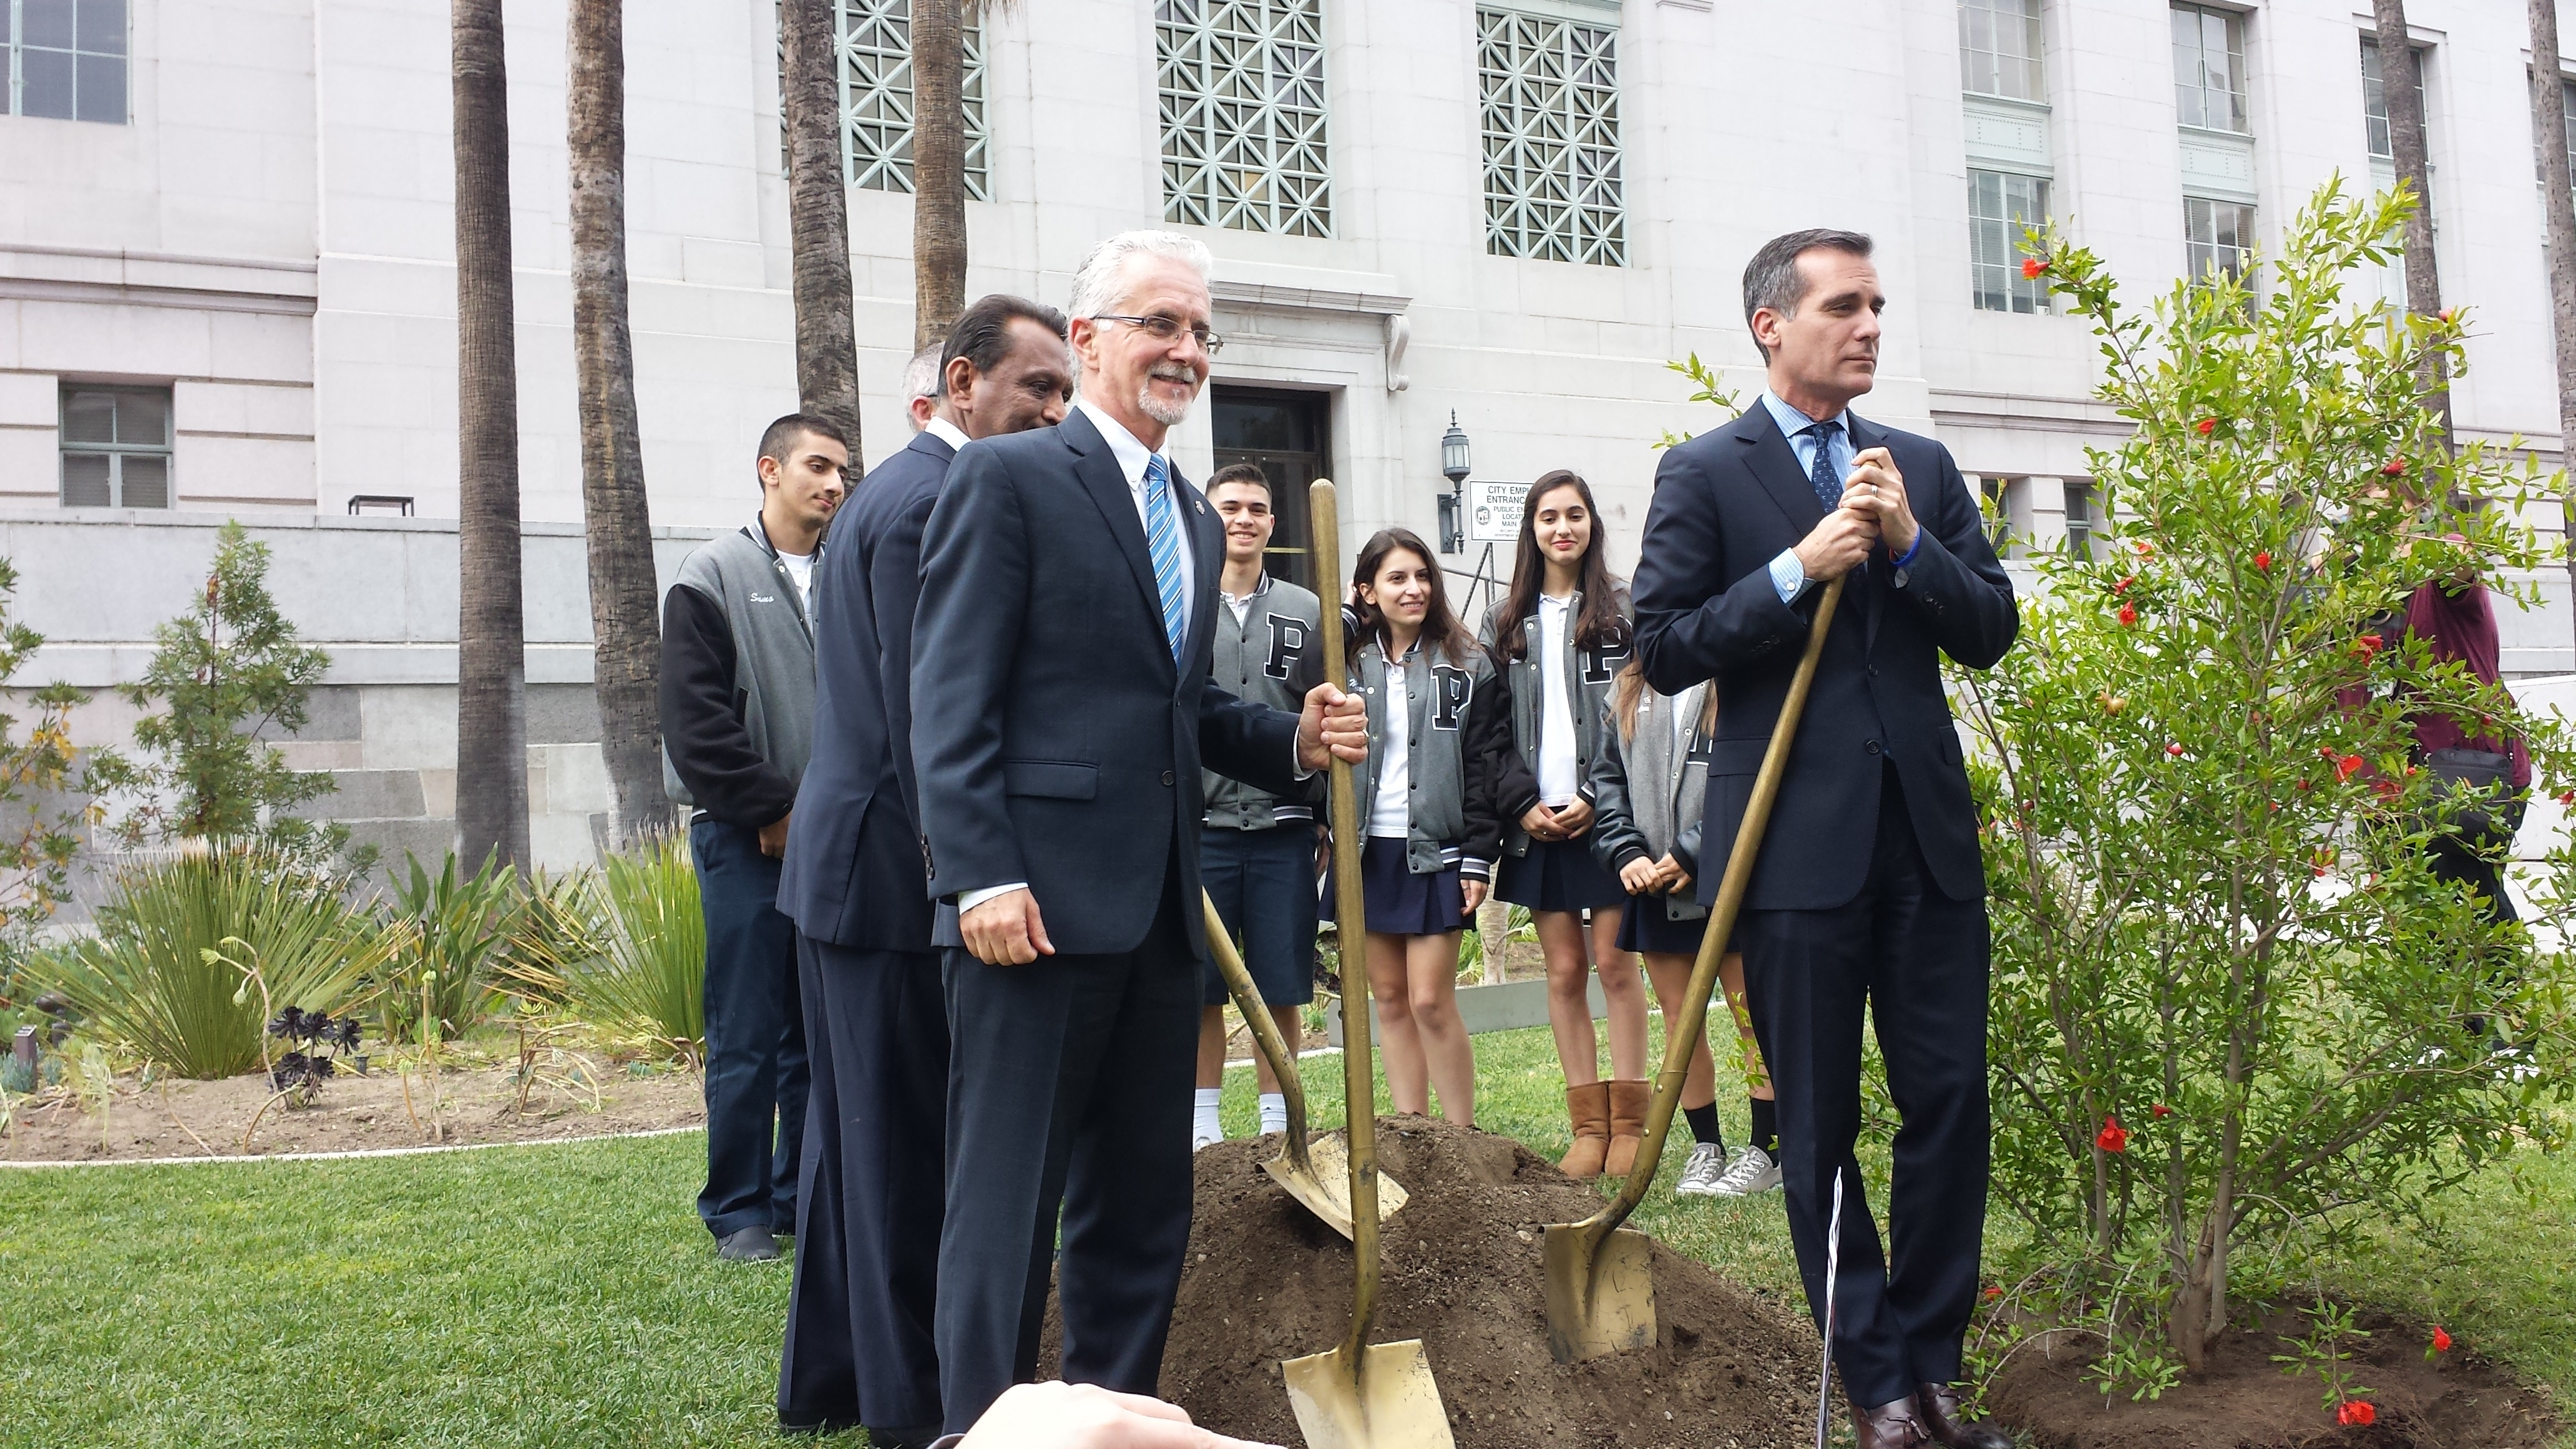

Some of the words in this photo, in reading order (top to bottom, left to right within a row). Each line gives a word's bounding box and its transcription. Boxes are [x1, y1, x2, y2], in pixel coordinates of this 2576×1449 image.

[1486, 495, 1525, 504] ENTRANC
[1488, 485, 1506, 494] CITY
[1264, 611, 1312, 680] P
[1583, 614, 1632, 685] P
[1430, 663, 1473, 731] P
